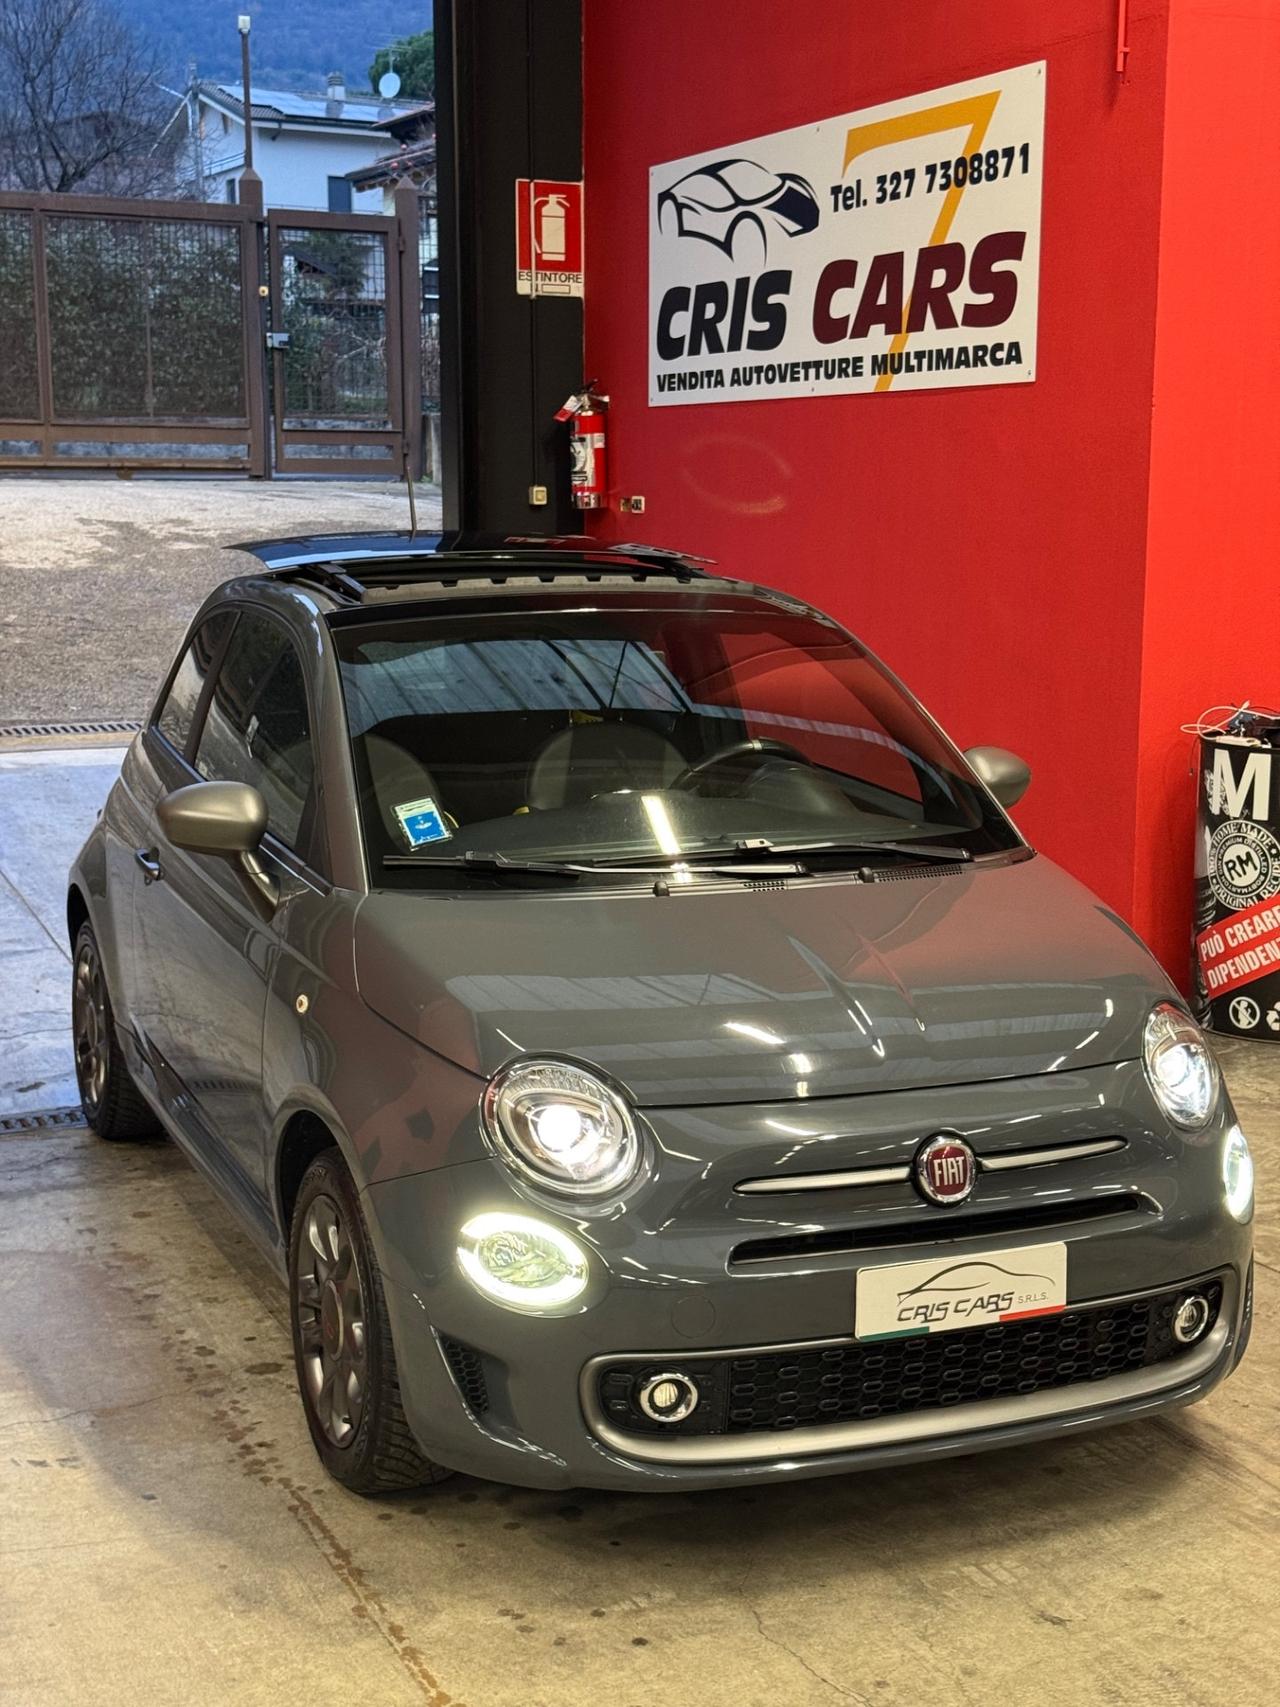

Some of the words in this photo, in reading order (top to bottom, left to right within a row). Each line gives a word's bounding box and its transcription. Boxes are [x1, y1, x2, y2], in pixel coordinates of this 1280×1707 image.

[830, 178, 868, 213] Tel.
[875, 168, 916, 204] 327
[924, 142, 1030, 194] 7308871
[518, 271, 583, 284] ESTINTORE
[656, 269, 793, 361] CRIS
[812, 231, 1027, 345] CARS
[656, 368, 726, 393] VENDITA
[729, 356, 864, 388] AUTOVETTURE
[870, 341, 1023, 377] MULTIMARCA
[1240, 823, 1273, 849] MADE
[1224, 851, 1258, 881] RM
[1200, 930, 1225, 962] PUÒ
[933, 1156, 965, 1187] FIAT
[897, 1302, 950, 1323] CRIS
[953, 1291, 1015, 1318] CARS
